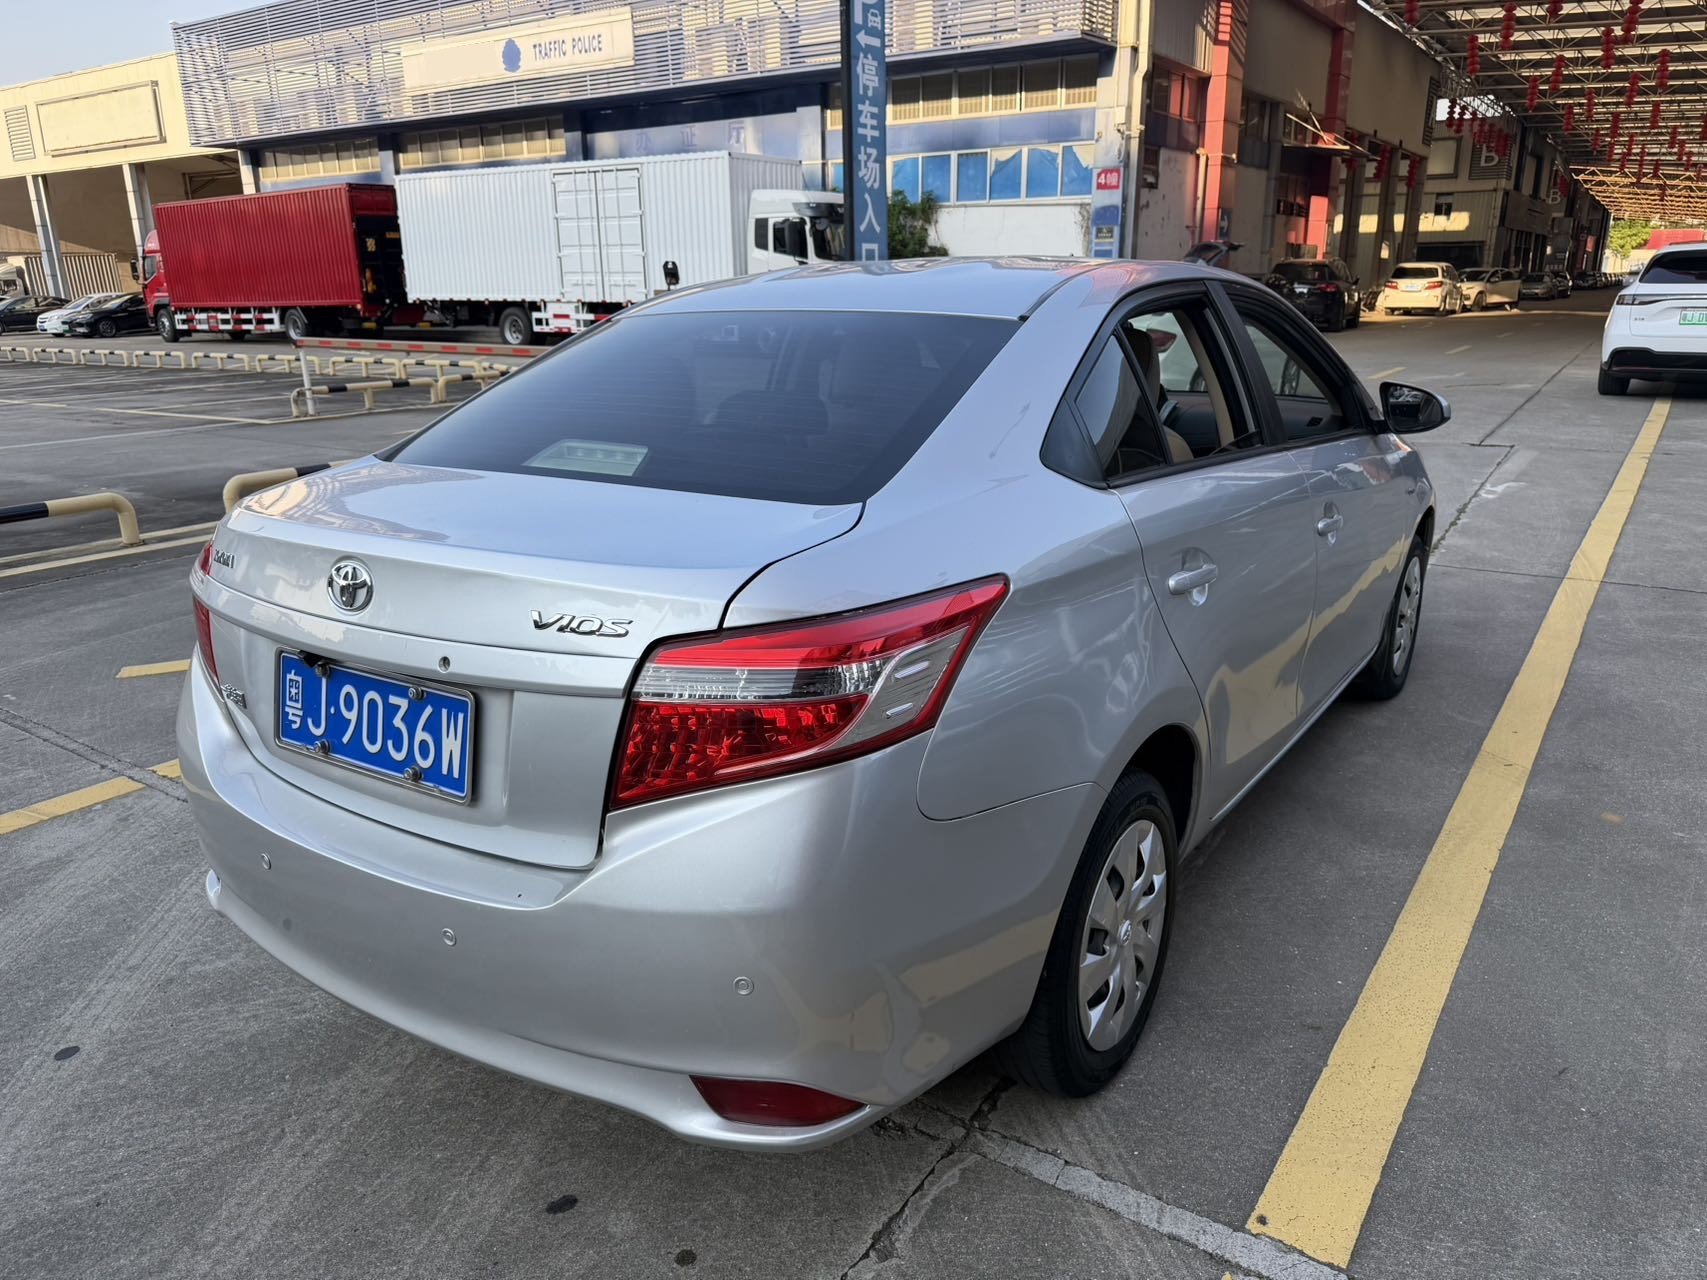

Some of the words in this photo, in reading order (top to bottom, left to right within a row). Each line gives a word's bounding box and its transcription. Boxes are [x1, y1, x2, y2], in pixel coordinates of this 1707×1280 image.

[533, 40, 567, 61] TRAFFIC
[572, 34, 602, 55] POLICE
[857, 52, 881, 261] 停车场入口
[529, 609, 634, 638] VIOS
